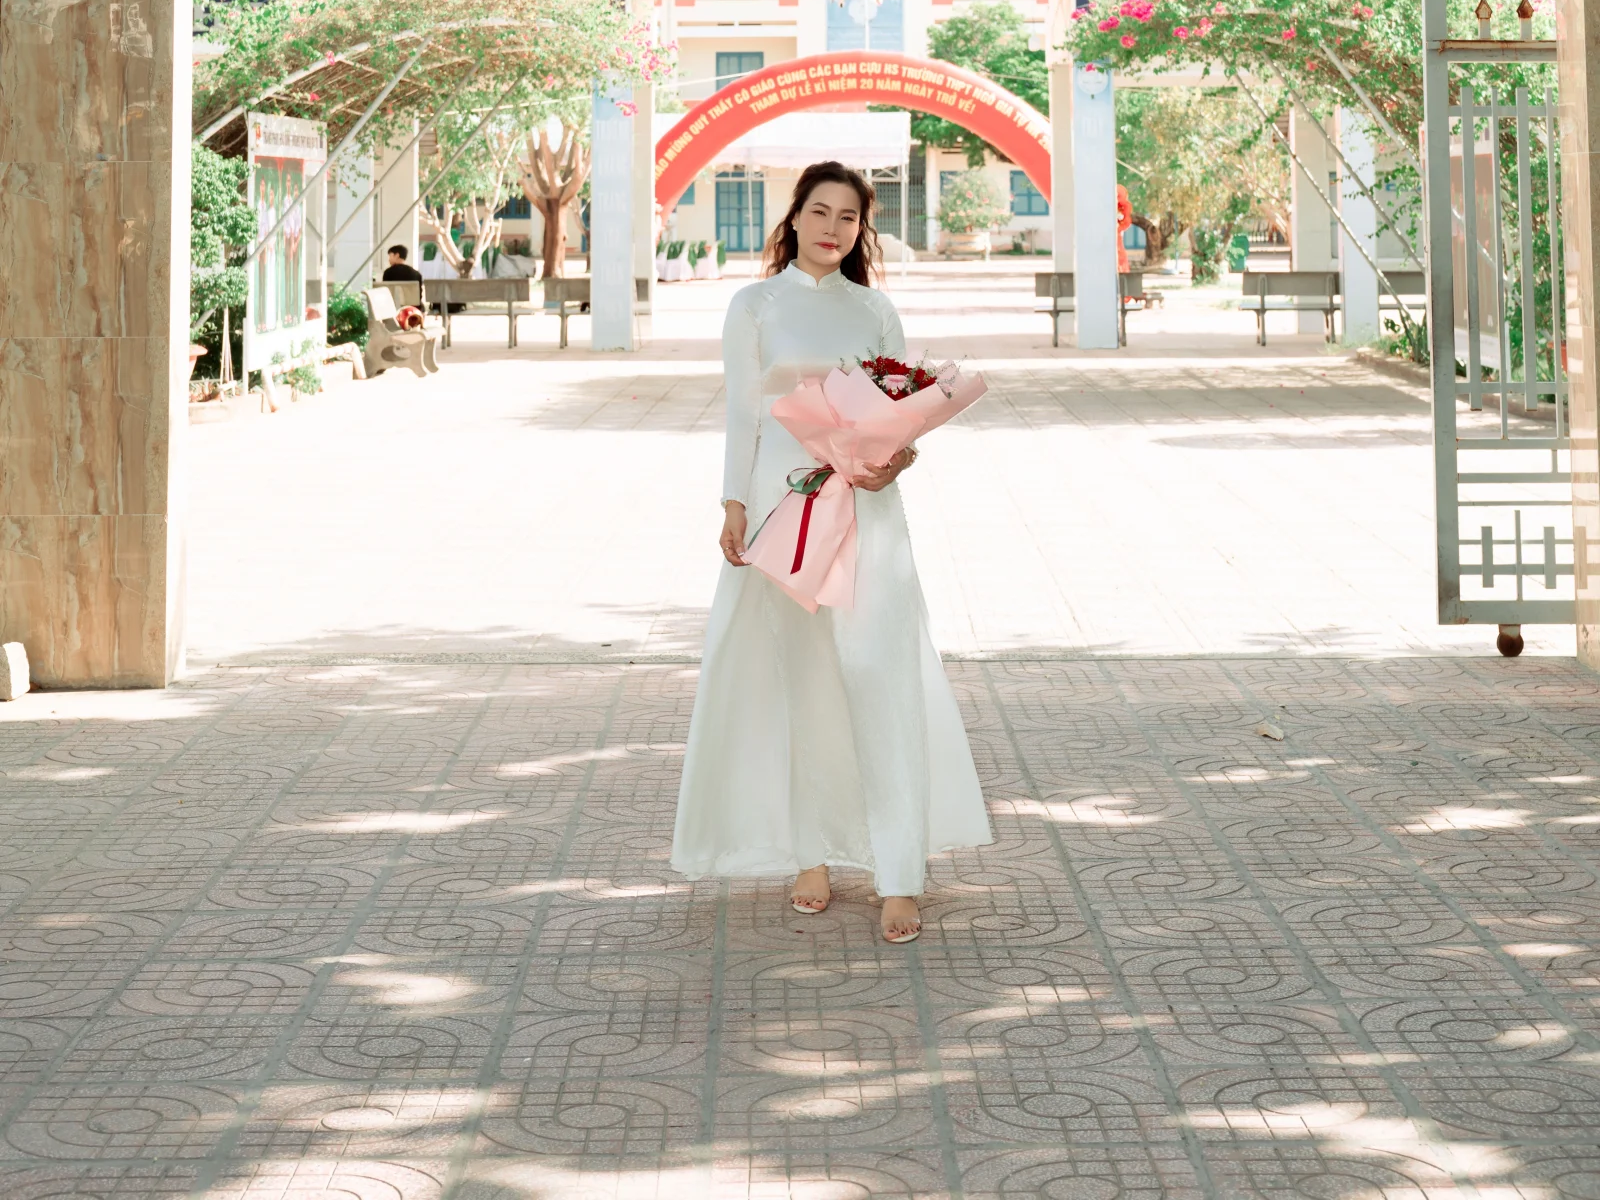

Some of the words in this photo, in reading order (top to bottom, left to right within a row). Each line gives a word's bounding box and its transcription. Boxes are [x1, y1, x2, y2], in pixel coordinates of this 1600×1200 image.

[734, 92, 750, 105] CÔ
[750, 78, 775, 97] GIÁO
[808, 63, 832, 79] CÁC
[833, 63, 857, 76] BẠN
[884, 63, 899, 75] HS
[901, 65, 945, 85] TRƯỜNG
[946, 76, 973, 95] THPT
[749, 92, 780, 114] THAM
[860, 78, 874, 90] 20
[904, 82, 934, 99] NGÀY
